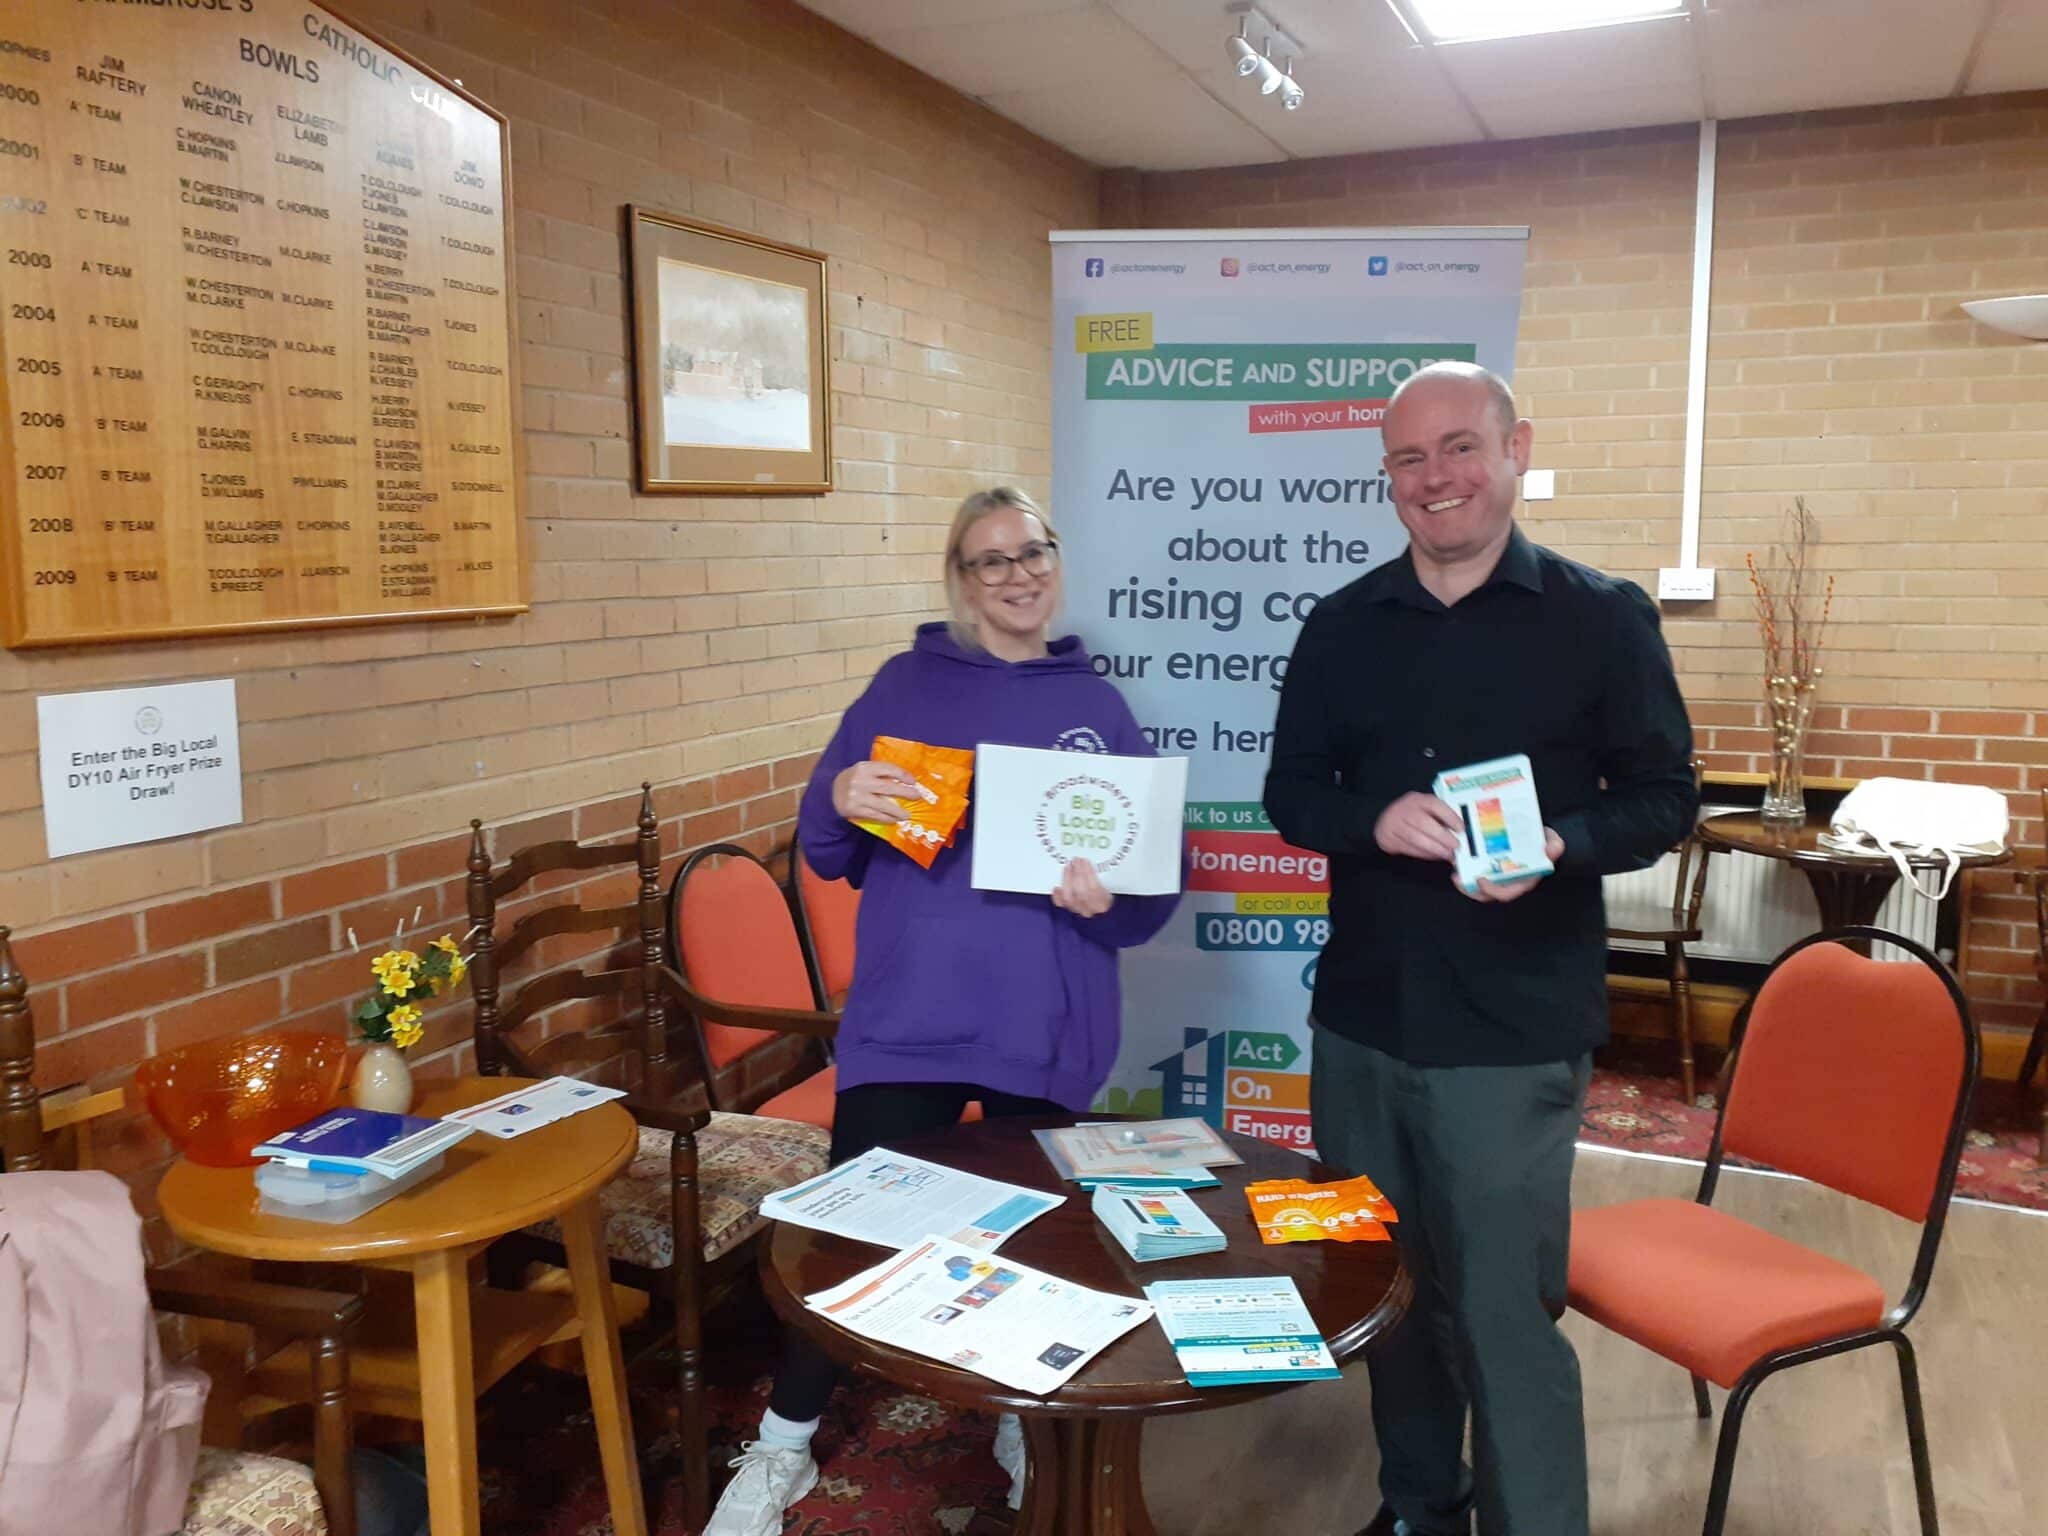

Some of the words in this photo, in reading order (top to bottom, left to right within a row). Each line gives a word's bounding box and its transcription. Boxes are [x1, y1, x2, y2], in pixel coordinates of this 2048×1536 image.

[239, 38, 320, 83] BOWLS
[303, 14, 403, 88] CATHOLIC
[99, 55, 125, 72] JIM
[77, 65, 147, 96] RAFTERY
[193, 81, 242, 106] CANON
[87, 104, 122, 122] TEAM
[182, 95, 253, 125] WHEATLEY
[294, 126, 328, 147] LAMB
[93, 158, 127, 175] TEAM
[94, 210, 130, 226] TEAM
[9, 249, 52, 269] 2003
[1247, 260, 1331, 276] @act_on_energy
[1395, 260, 1480, 276] @act_on_energy
[96, 263, 132, 278] TEAM
[13, 304, 56, 322] 2004
[104, 315, 139, 330] TEAM
[1088, 318, 1141, 343] FREE
[17, 358, 62, 376] 2005
[107, 367, 143, 380] TEAM
[1105, 358, 1234, 387] ADVICE
[1242, 363, 1296, 384] AND
[1305, 358, 1456, 387] SUPPO
[21, 411, 65, 428] 2006
[112, 419, 147, 432] TEAM
[1258, 408, 1296, 425] with
[1302, 410, 1344, 430] your
[25, 465, 67, 480] 2007
[116, 470, 152, 482] TEAM
[1106, 469, 1175, 501] Are
[1190, 476, 1262, 510] you
[30, 518, 74, 532] 2008
[120, 520, 155, 532] TEAM
[1168, 529, 1288, 563] about
[1303, 530, 1369, 564] the
[35, 570, 77, 585] 2009
[123, 570, 158, 582] TEAM
[1108, 576, 1242, 631] rising
[1263, 591, 1320, 622] co
[1167, 652, 1290, 693] energ
[1143, 726, 1197, 750] are
[71, 750, 117, 767] Enter
[122, 746, 146, 760] the
[152, 742, 176, 758] Big
[181, 735, 217, 753] Local
[68, 770, 112, 788] DY10
[117, 766, 140, 782] Air
[146, 762, 184, 779] Fryer
[189, 756, 222, 771] Prize
[130, 782, 175, 800] Draw!
[1071, 793, 1105, 815] Big
[1058, 813, 1117, 833] Local
[1210, 808, 1227, 824] to
[1233, 811, 1252, 824] us
[1061, 831, 1112, 849] DY10
[1191, 846, 1328, 882] tonenerg
[1243, 900, 1258, 911] or
[1264, 897, 1291, 910] call
[1296, 899, 1321, 911] our
[1206, 919, 1284, 946] 0800
[1294, 919, 1331, 946] 98
[1233, 1037, 1283, 1062] Act
[1231, 1076, 1272, 1101] On
[1232, 1114, 1312, 1146] Energ
